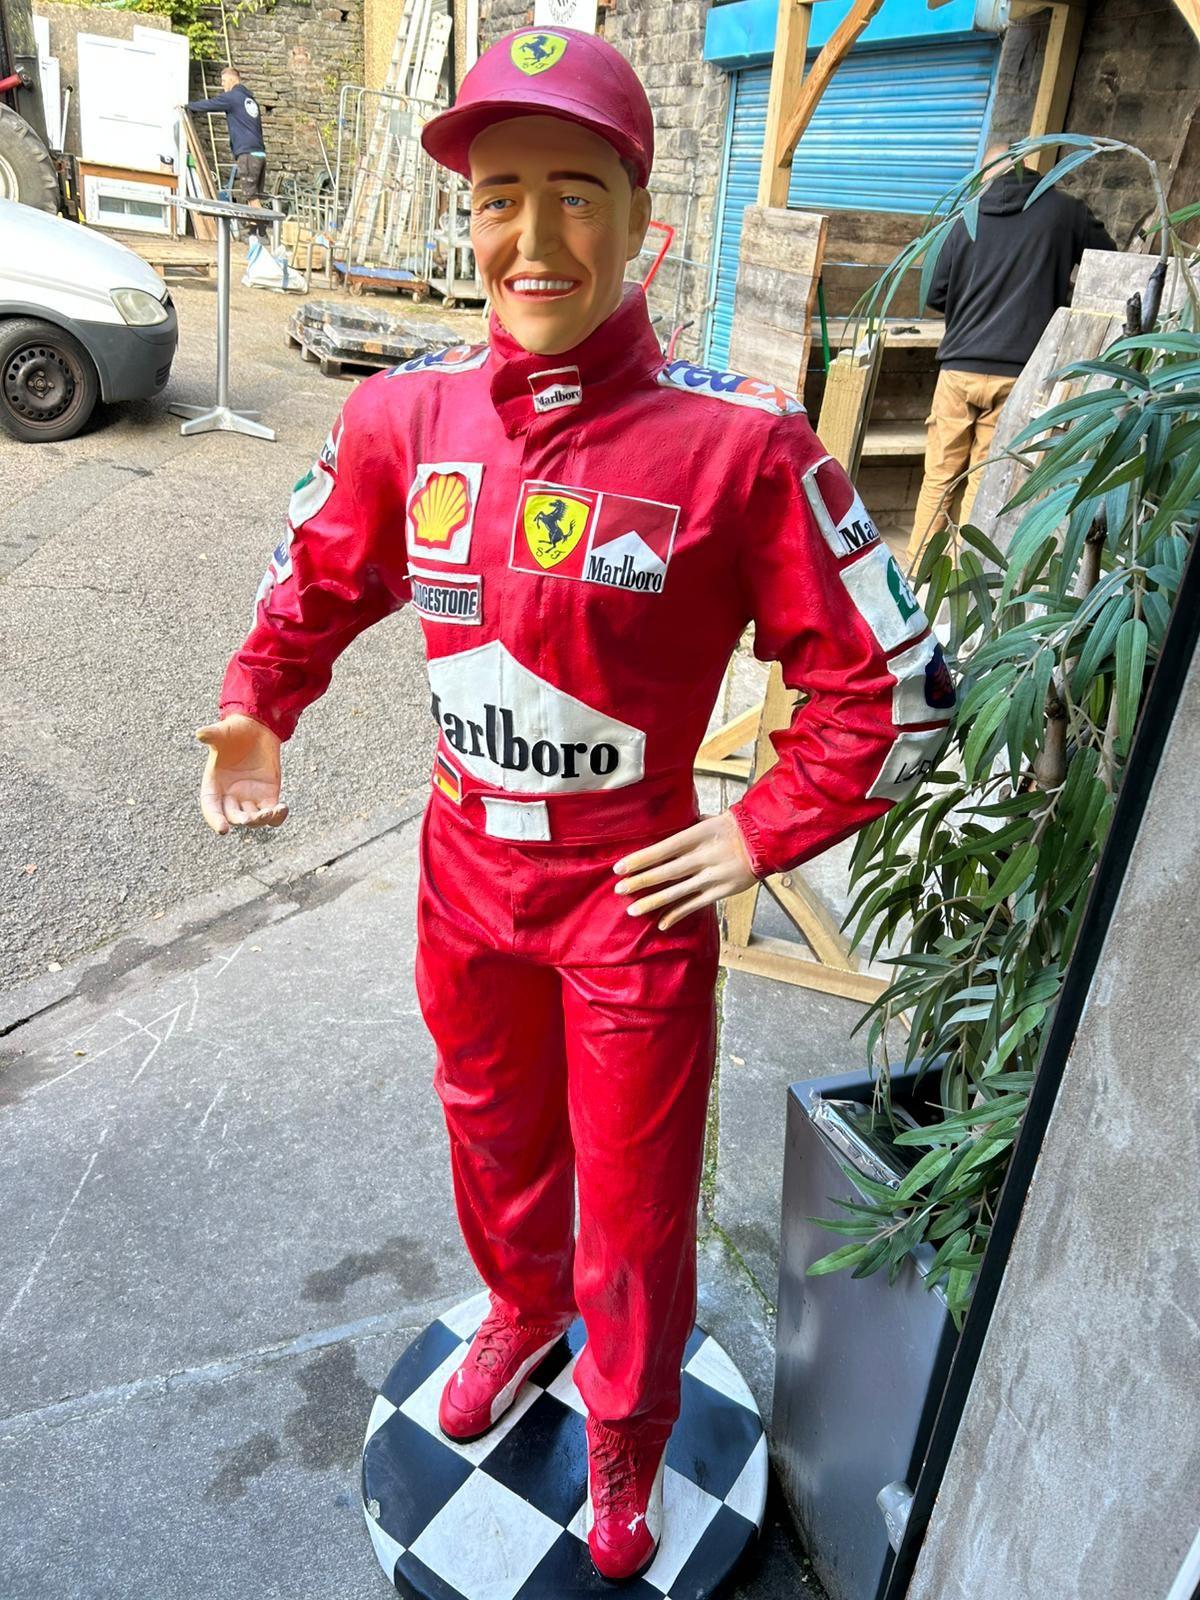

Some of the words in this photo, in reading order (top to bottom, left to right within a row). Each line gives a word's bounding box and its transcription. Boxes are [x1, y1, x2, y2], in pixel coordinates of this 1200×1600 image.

[839, 520, 880, 552] Ma
[586, 554, 663, 592] Marlboro
[414, 583, 478, 616] GESTONE
